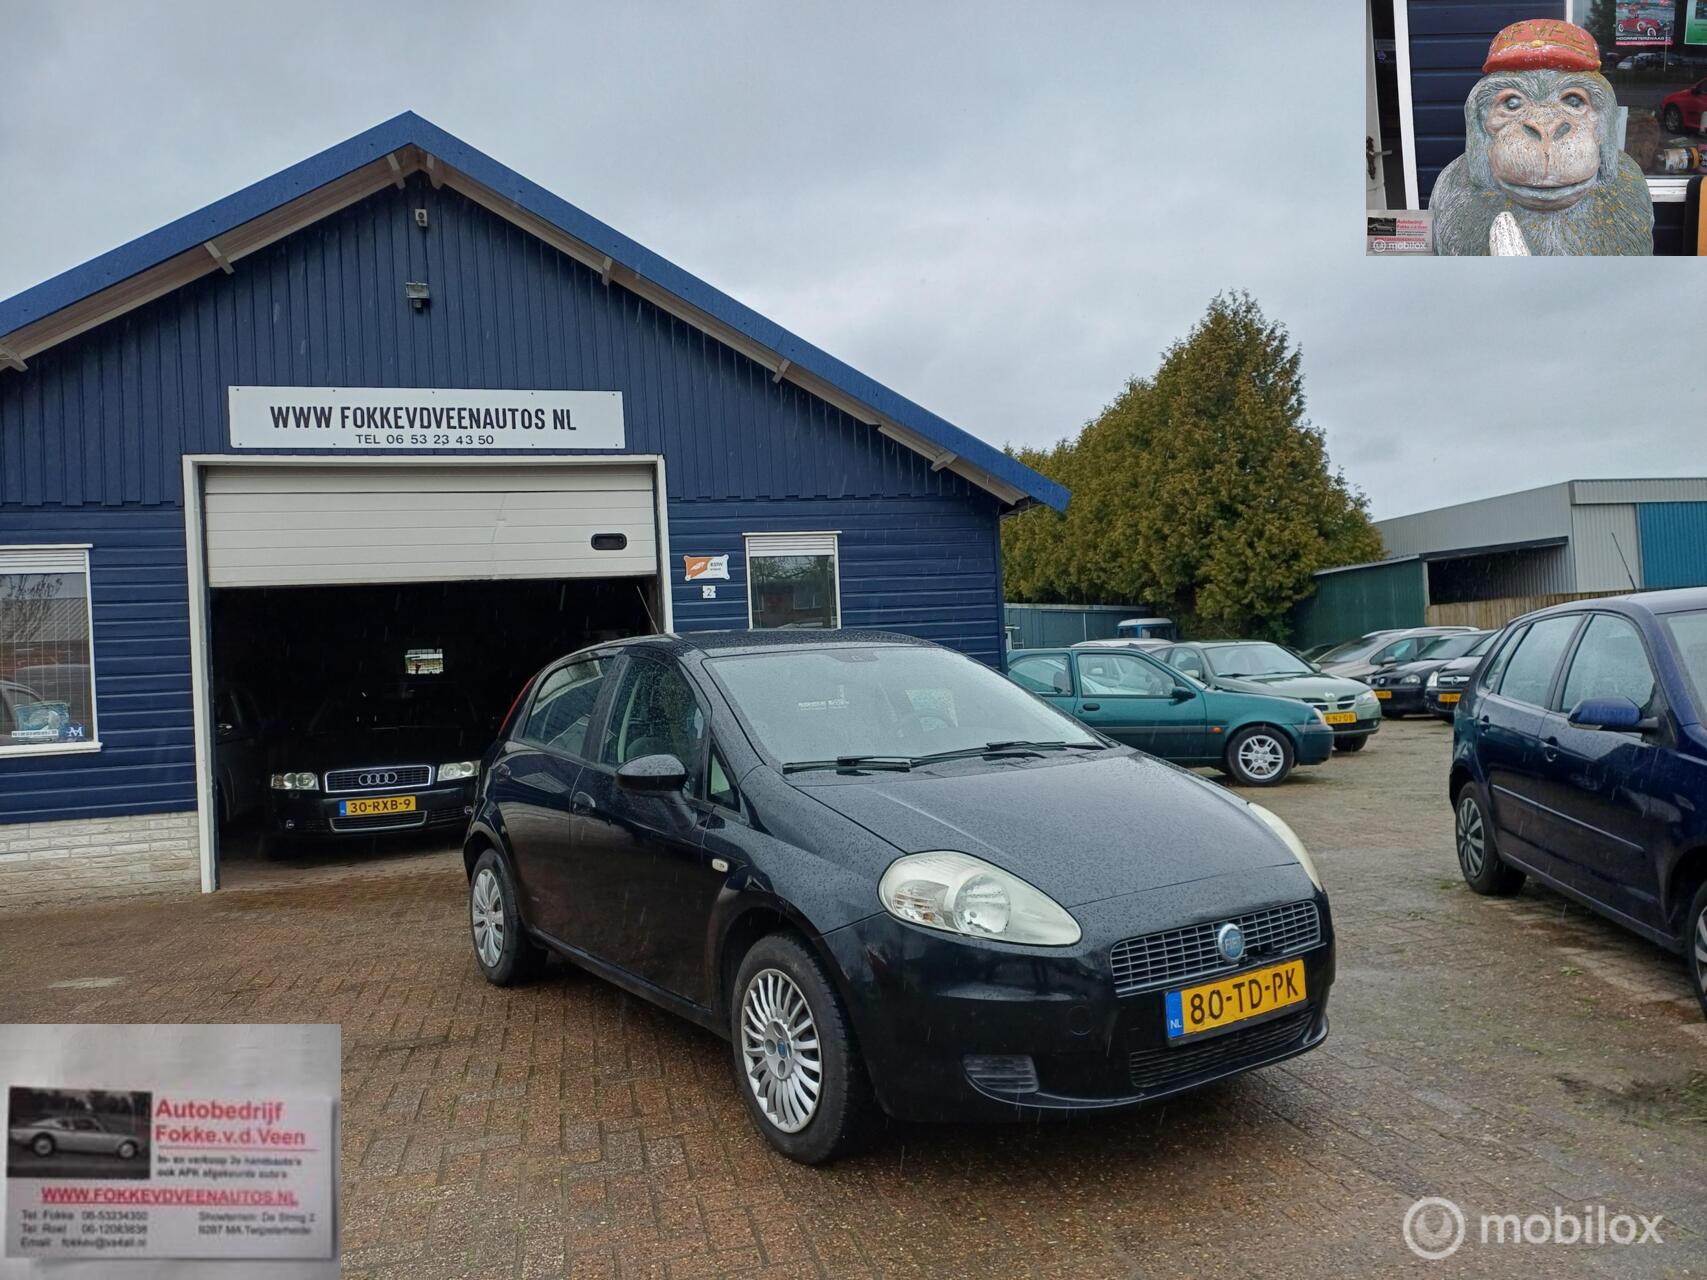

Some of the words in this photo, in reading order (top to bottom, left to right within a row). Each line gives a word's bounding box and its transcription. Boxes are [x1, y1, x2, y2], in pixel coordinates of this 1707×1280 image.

[270, 406, 332, 428] WWW
[340, 406, 545, 430] FOKKEVDVEENAUTOS
[553, 409, 577, 431] NL
[355, 434, 380, 444] TEL
[386, 434, 404, 444] 06
[410, 434, 427, 444] 53
[433, 434, 450, 445] 23
[455, 435, 474, 445] 43
[478, 435, 495, 445] 50
[350, 798, 411, 813] 30-RXB-9
[1189, 967, 1299, 1025] 80-TD-PK
[1170, 1019, 1182, 1029] NL
